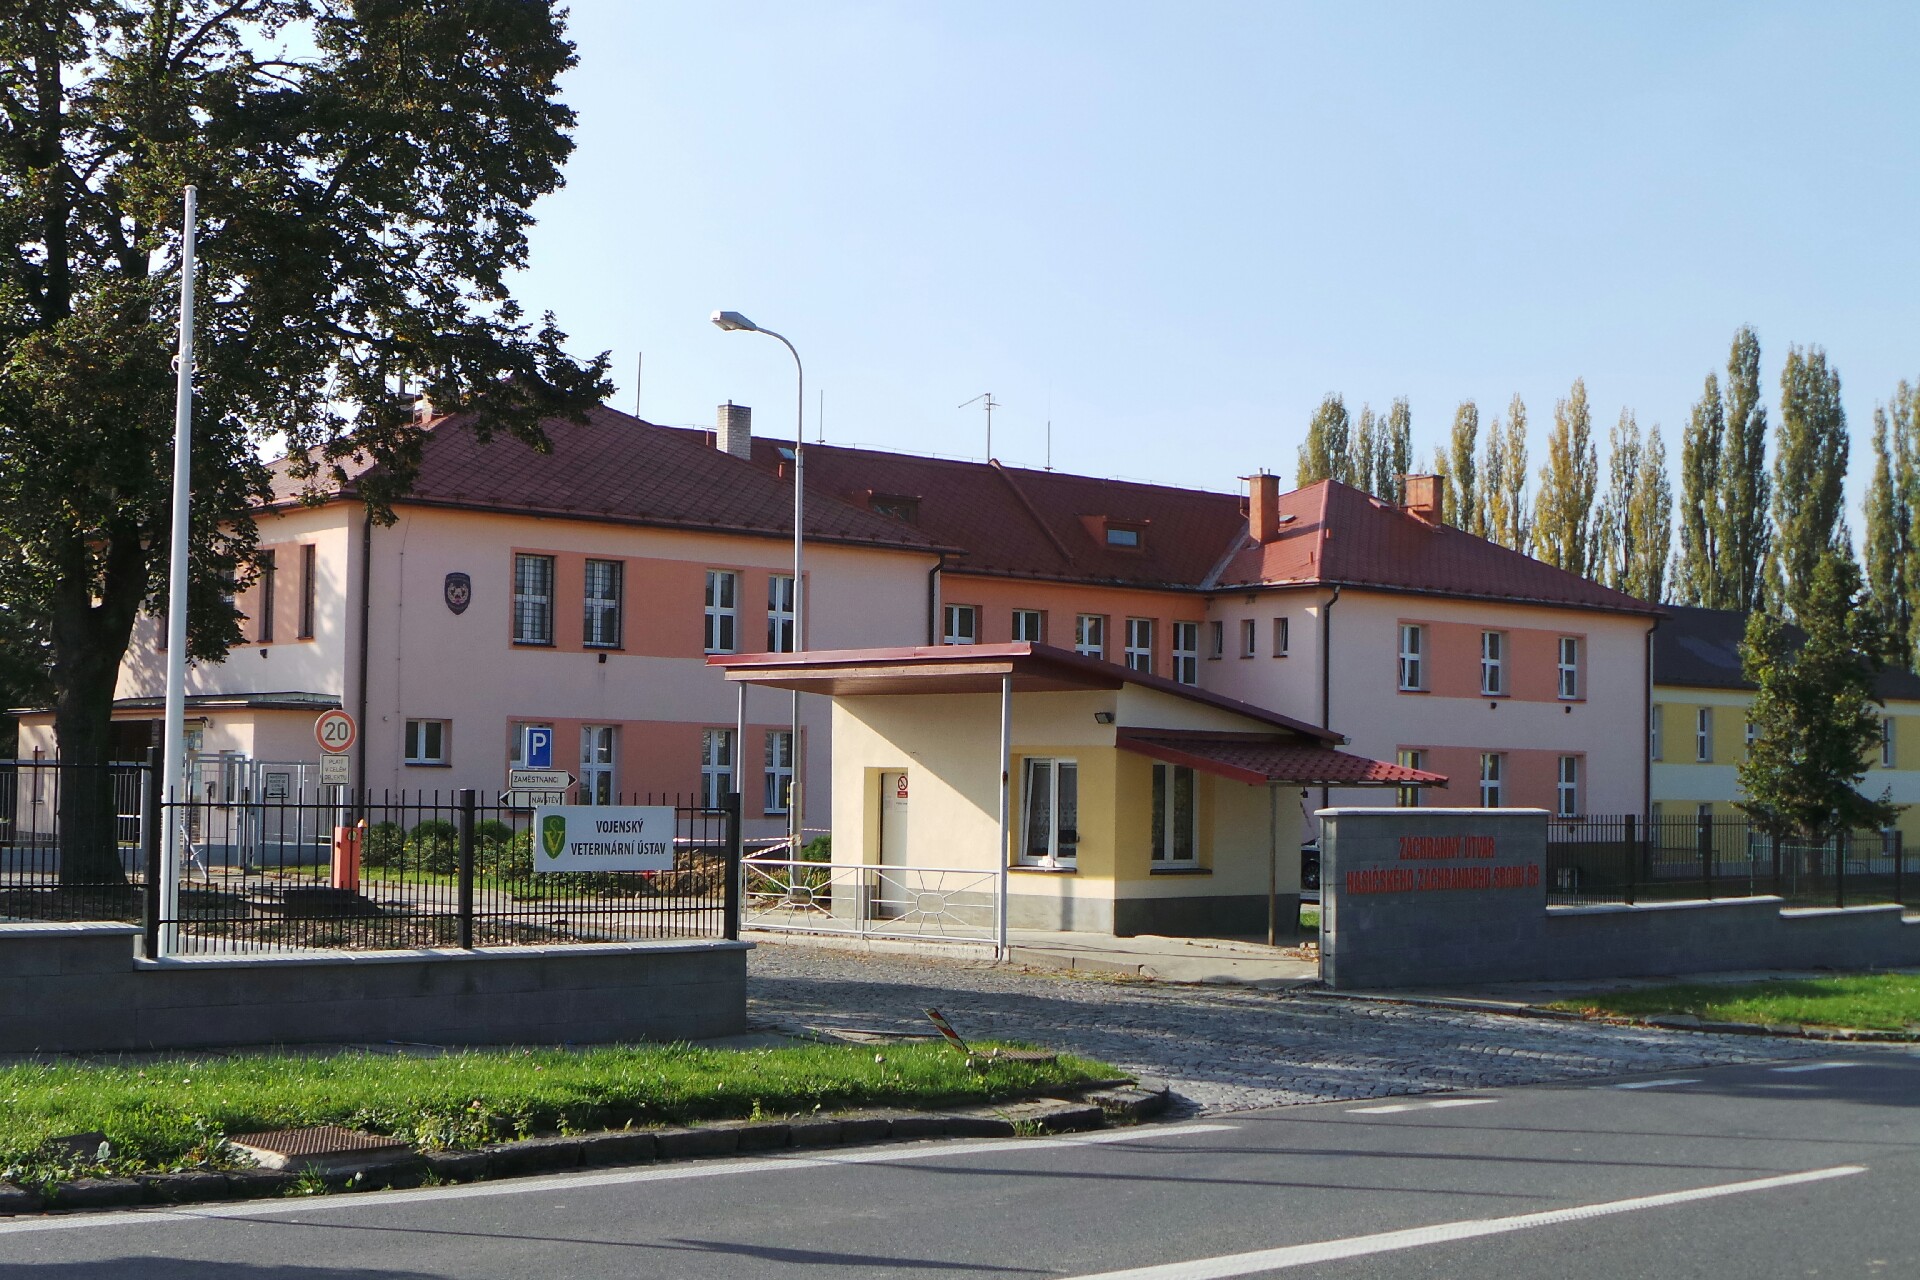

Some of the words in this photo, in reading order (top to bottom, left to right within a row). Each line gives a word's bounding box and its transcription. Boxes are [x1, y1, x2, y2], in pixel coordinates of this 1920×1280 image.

[325, 722, 348, 740] 20
[533, 733, 547, 756] P
[513, 774, 559, 784] ZAMĚSTNANCI
[595, 818, 644, 834] VOJENSKÝ
[571, 840, 634, 856] VETERINÁRNÍ
[637, 839, 666, 855] ÚSTAV
[1399, 832, 1461, 860] ZÁCHRANNÝ
[1464, 831, 1494, 859] ÚTVAR
[1346, 865, 1414, 895] HASIČSKÉHO
[1493, 865, 1525, 889] SBORU
[1527, 861, 1540, 888] ČR
